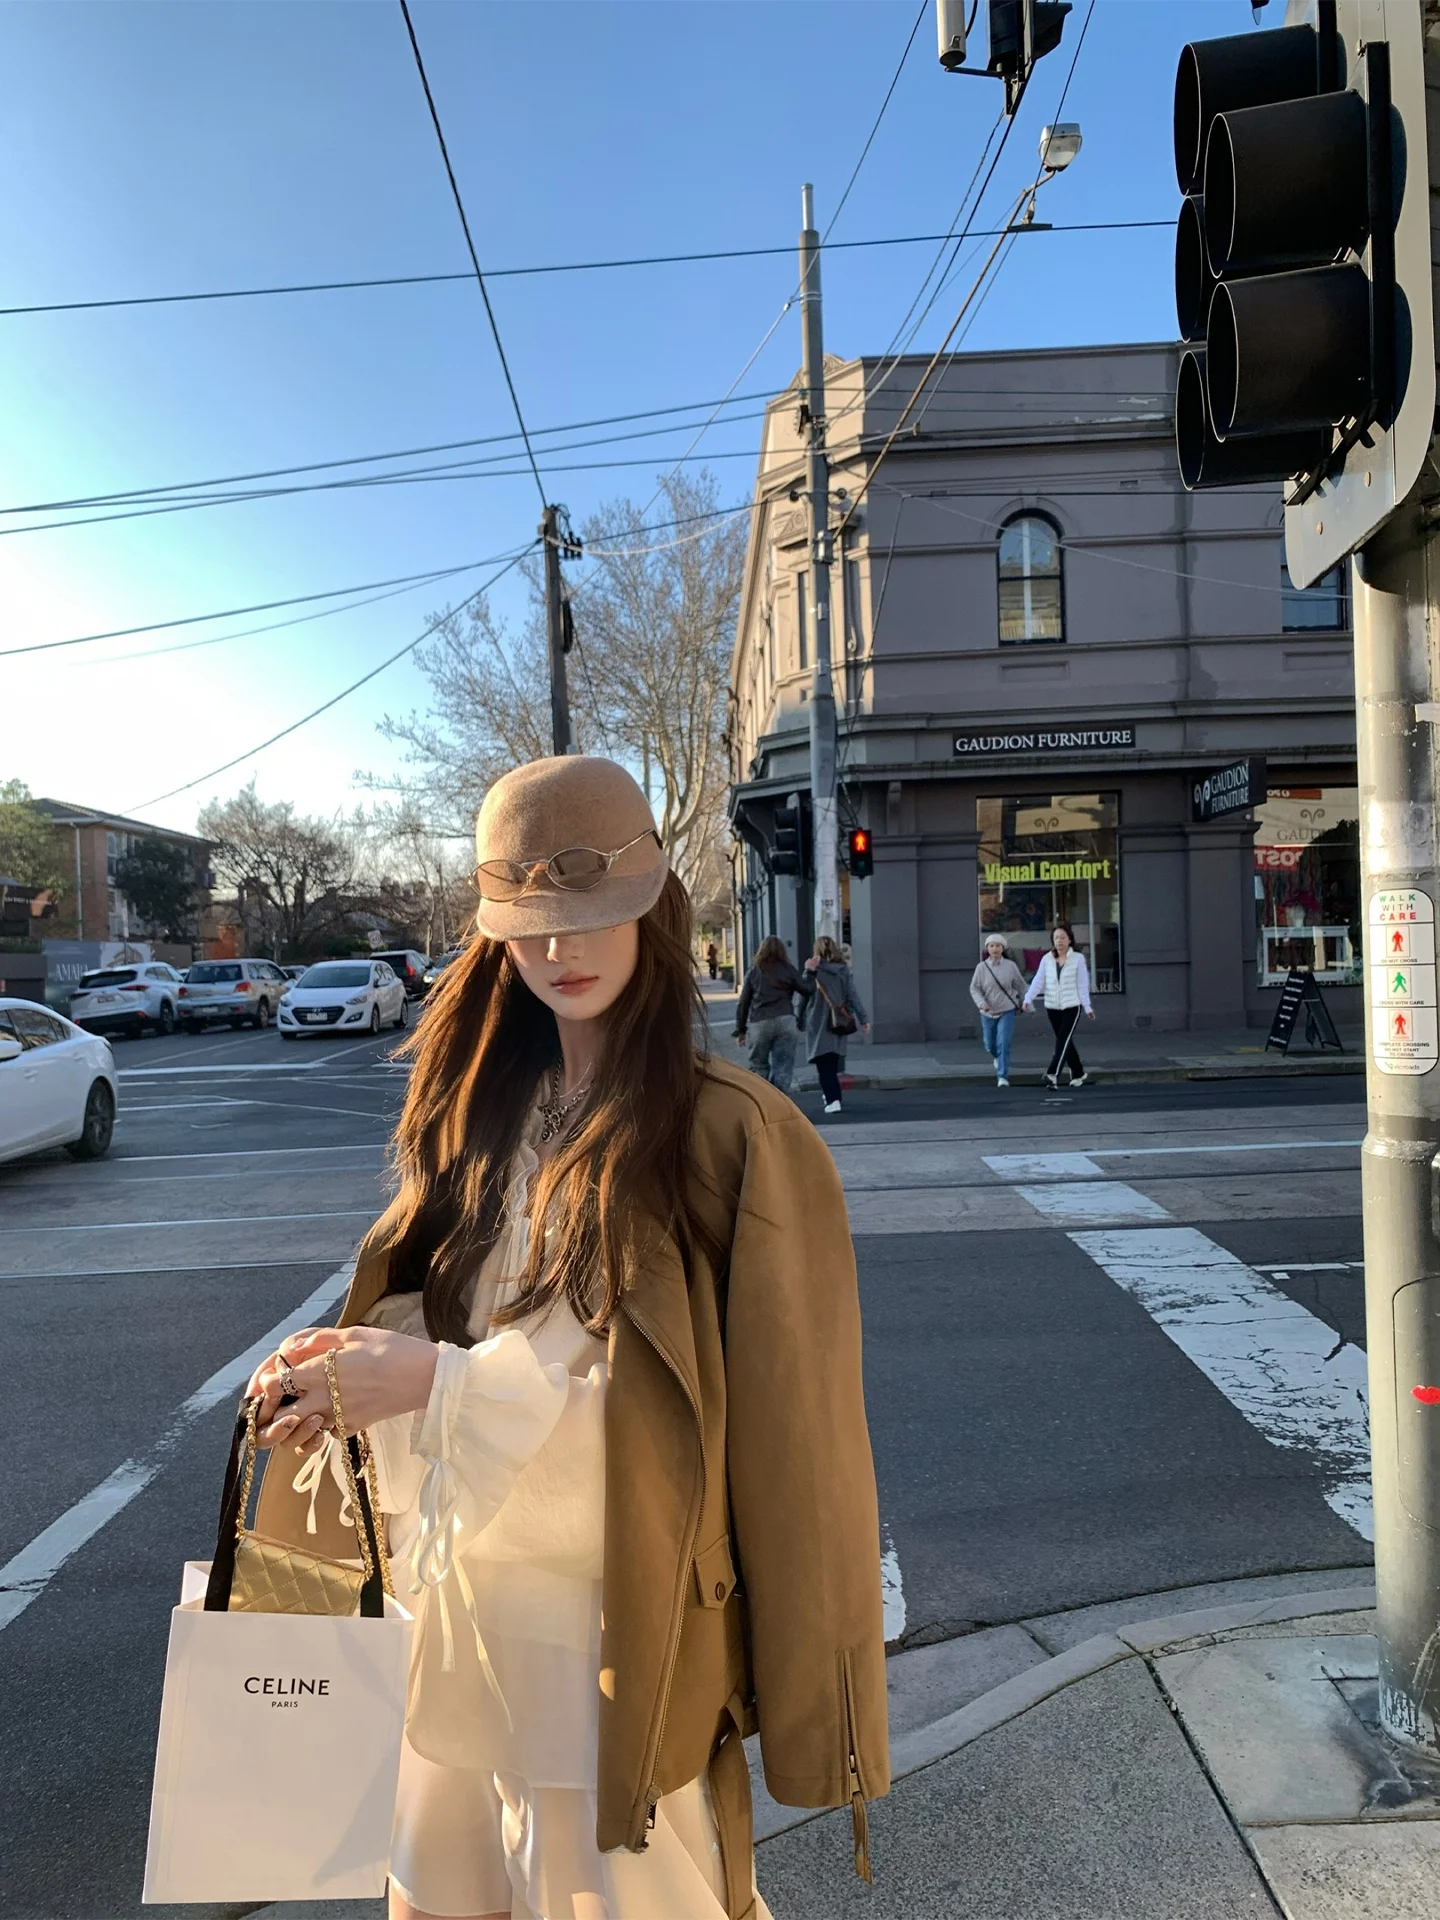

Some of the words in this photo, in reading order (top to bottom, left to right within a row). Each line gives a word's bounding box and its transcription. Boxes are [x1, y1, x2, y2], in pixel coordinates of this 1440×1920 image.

[955, 734, 1034, 752] GAUDION
[1038, 730, 1132, 748] FURNITURE
[1210, 763, 1249, 795] GAUDION
[1211, 786, 1249, 814] FURNITURE
[984, 861, 1036, 883] Visual
[1040, 859, 1112, 882] Comfort
[1379, 894, 1416, 902] WALK
[1382, 904, 1413, 912] WITH
[1379, 912, 1417, 921] CARE
[244, 1677, 330, 1696] CELINE
